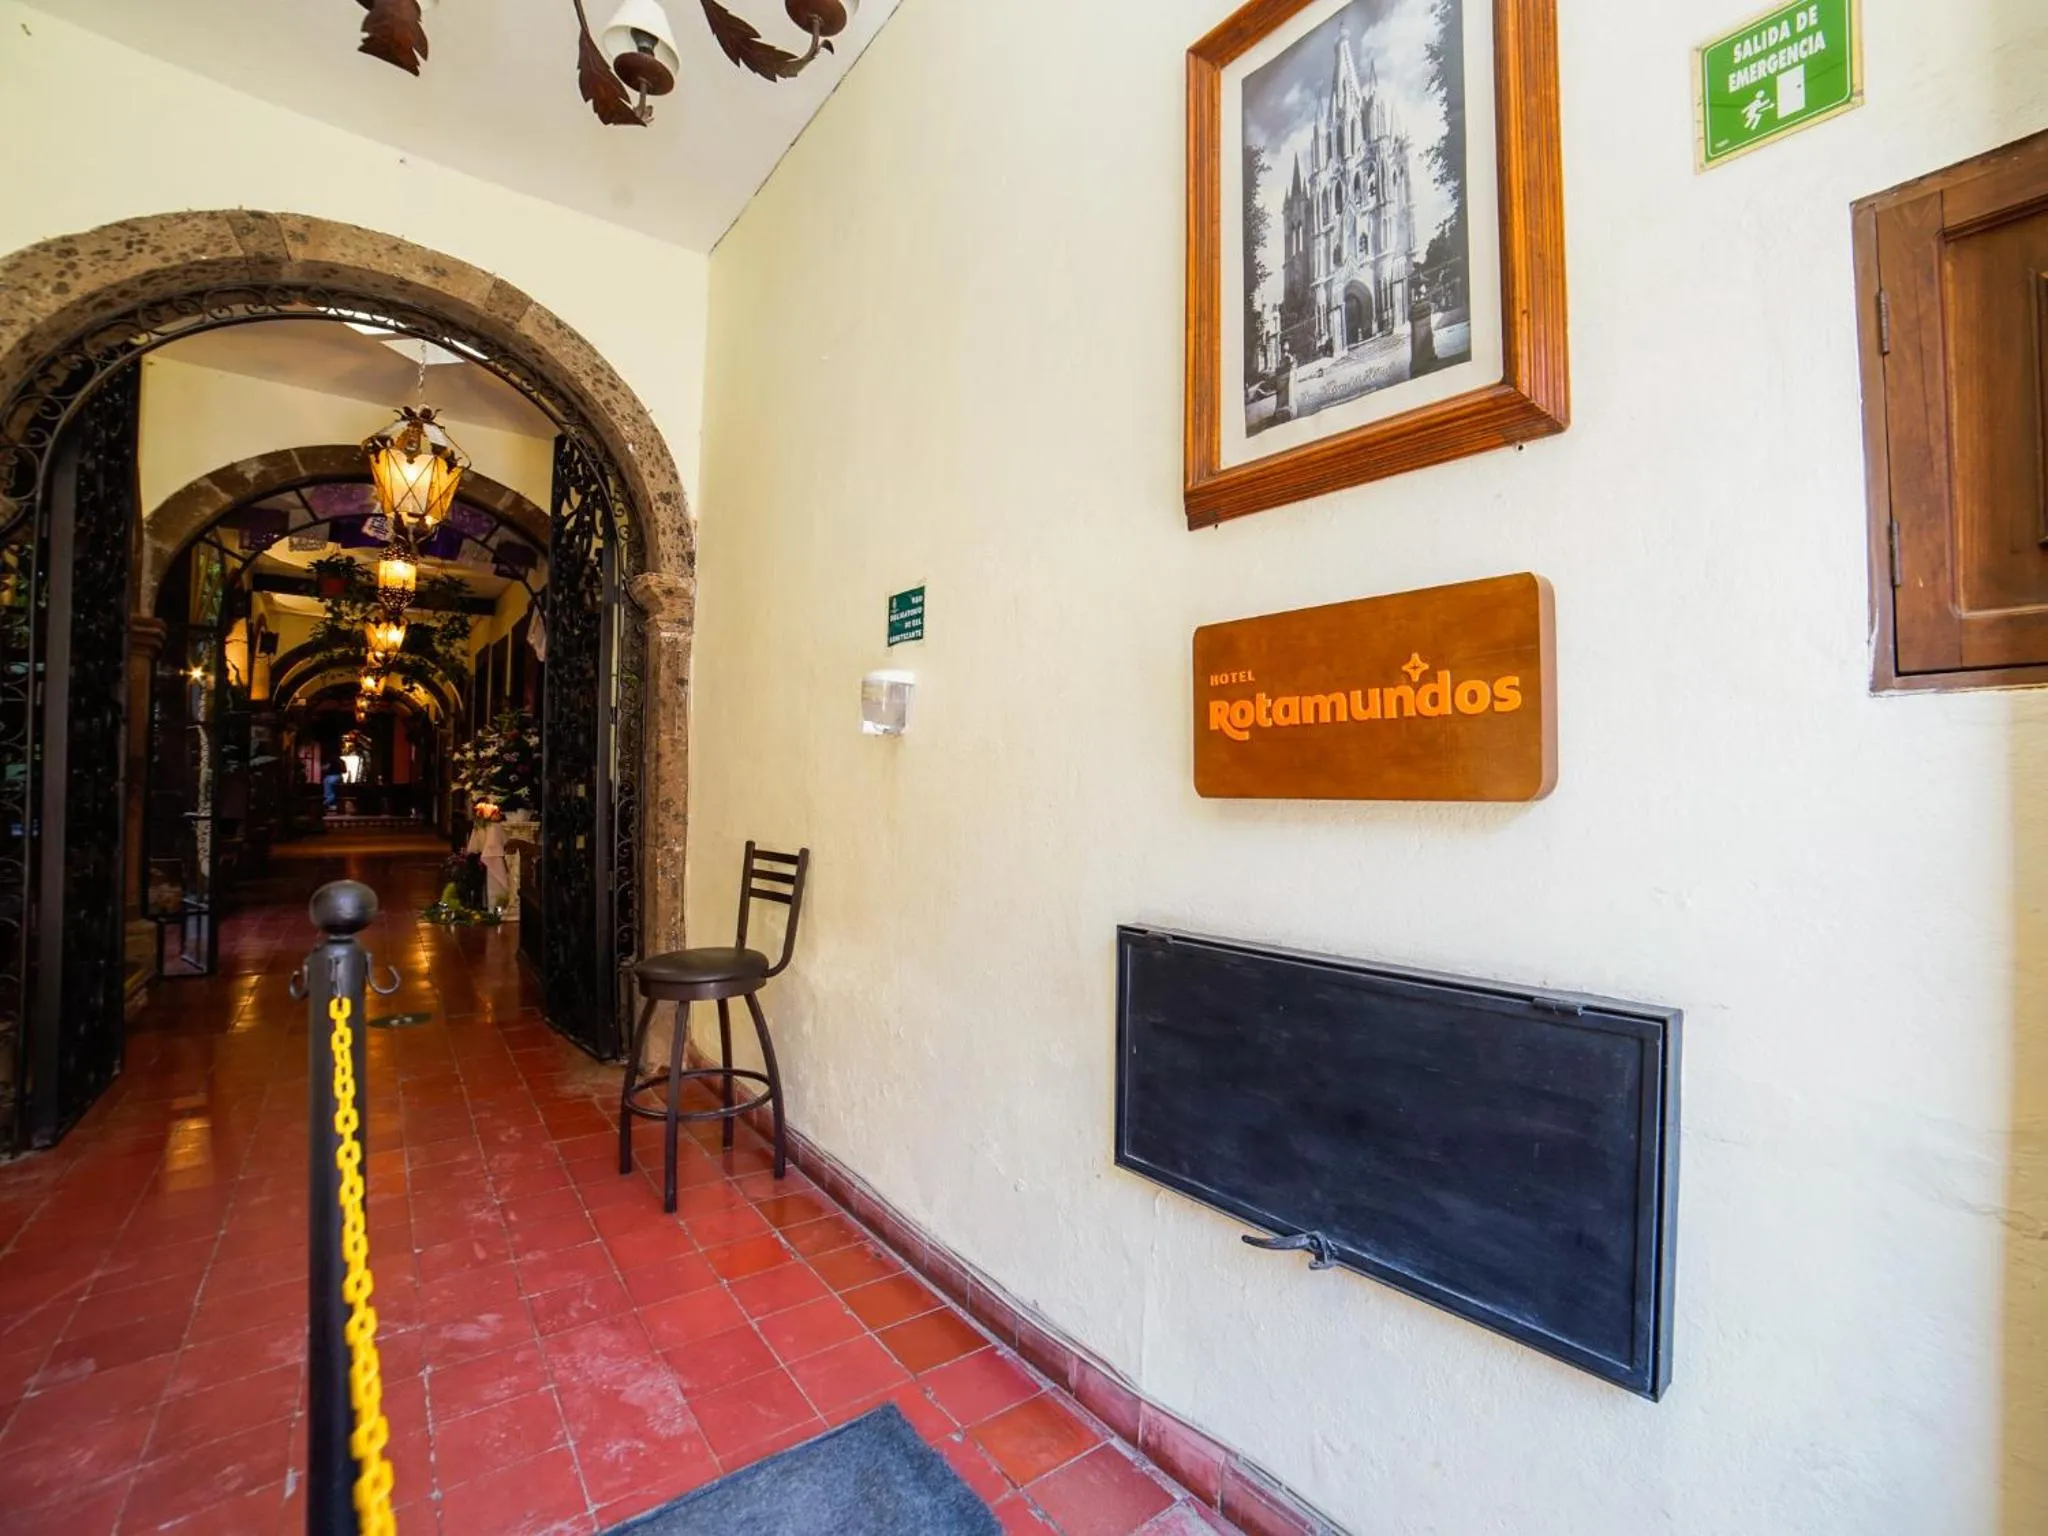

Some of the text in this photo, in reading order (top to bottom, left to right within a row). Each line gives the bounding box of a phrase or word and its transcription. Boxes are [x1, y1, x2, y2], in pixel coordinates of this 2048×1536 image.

[1728, 30, 1826, 93] EMERGENCIA
[1733, 4, 1819, 64] SALIDA DE
[1209, 670, 1522, 741] Rotamundos
[1210, 669, 1256, 687] HOTEL
